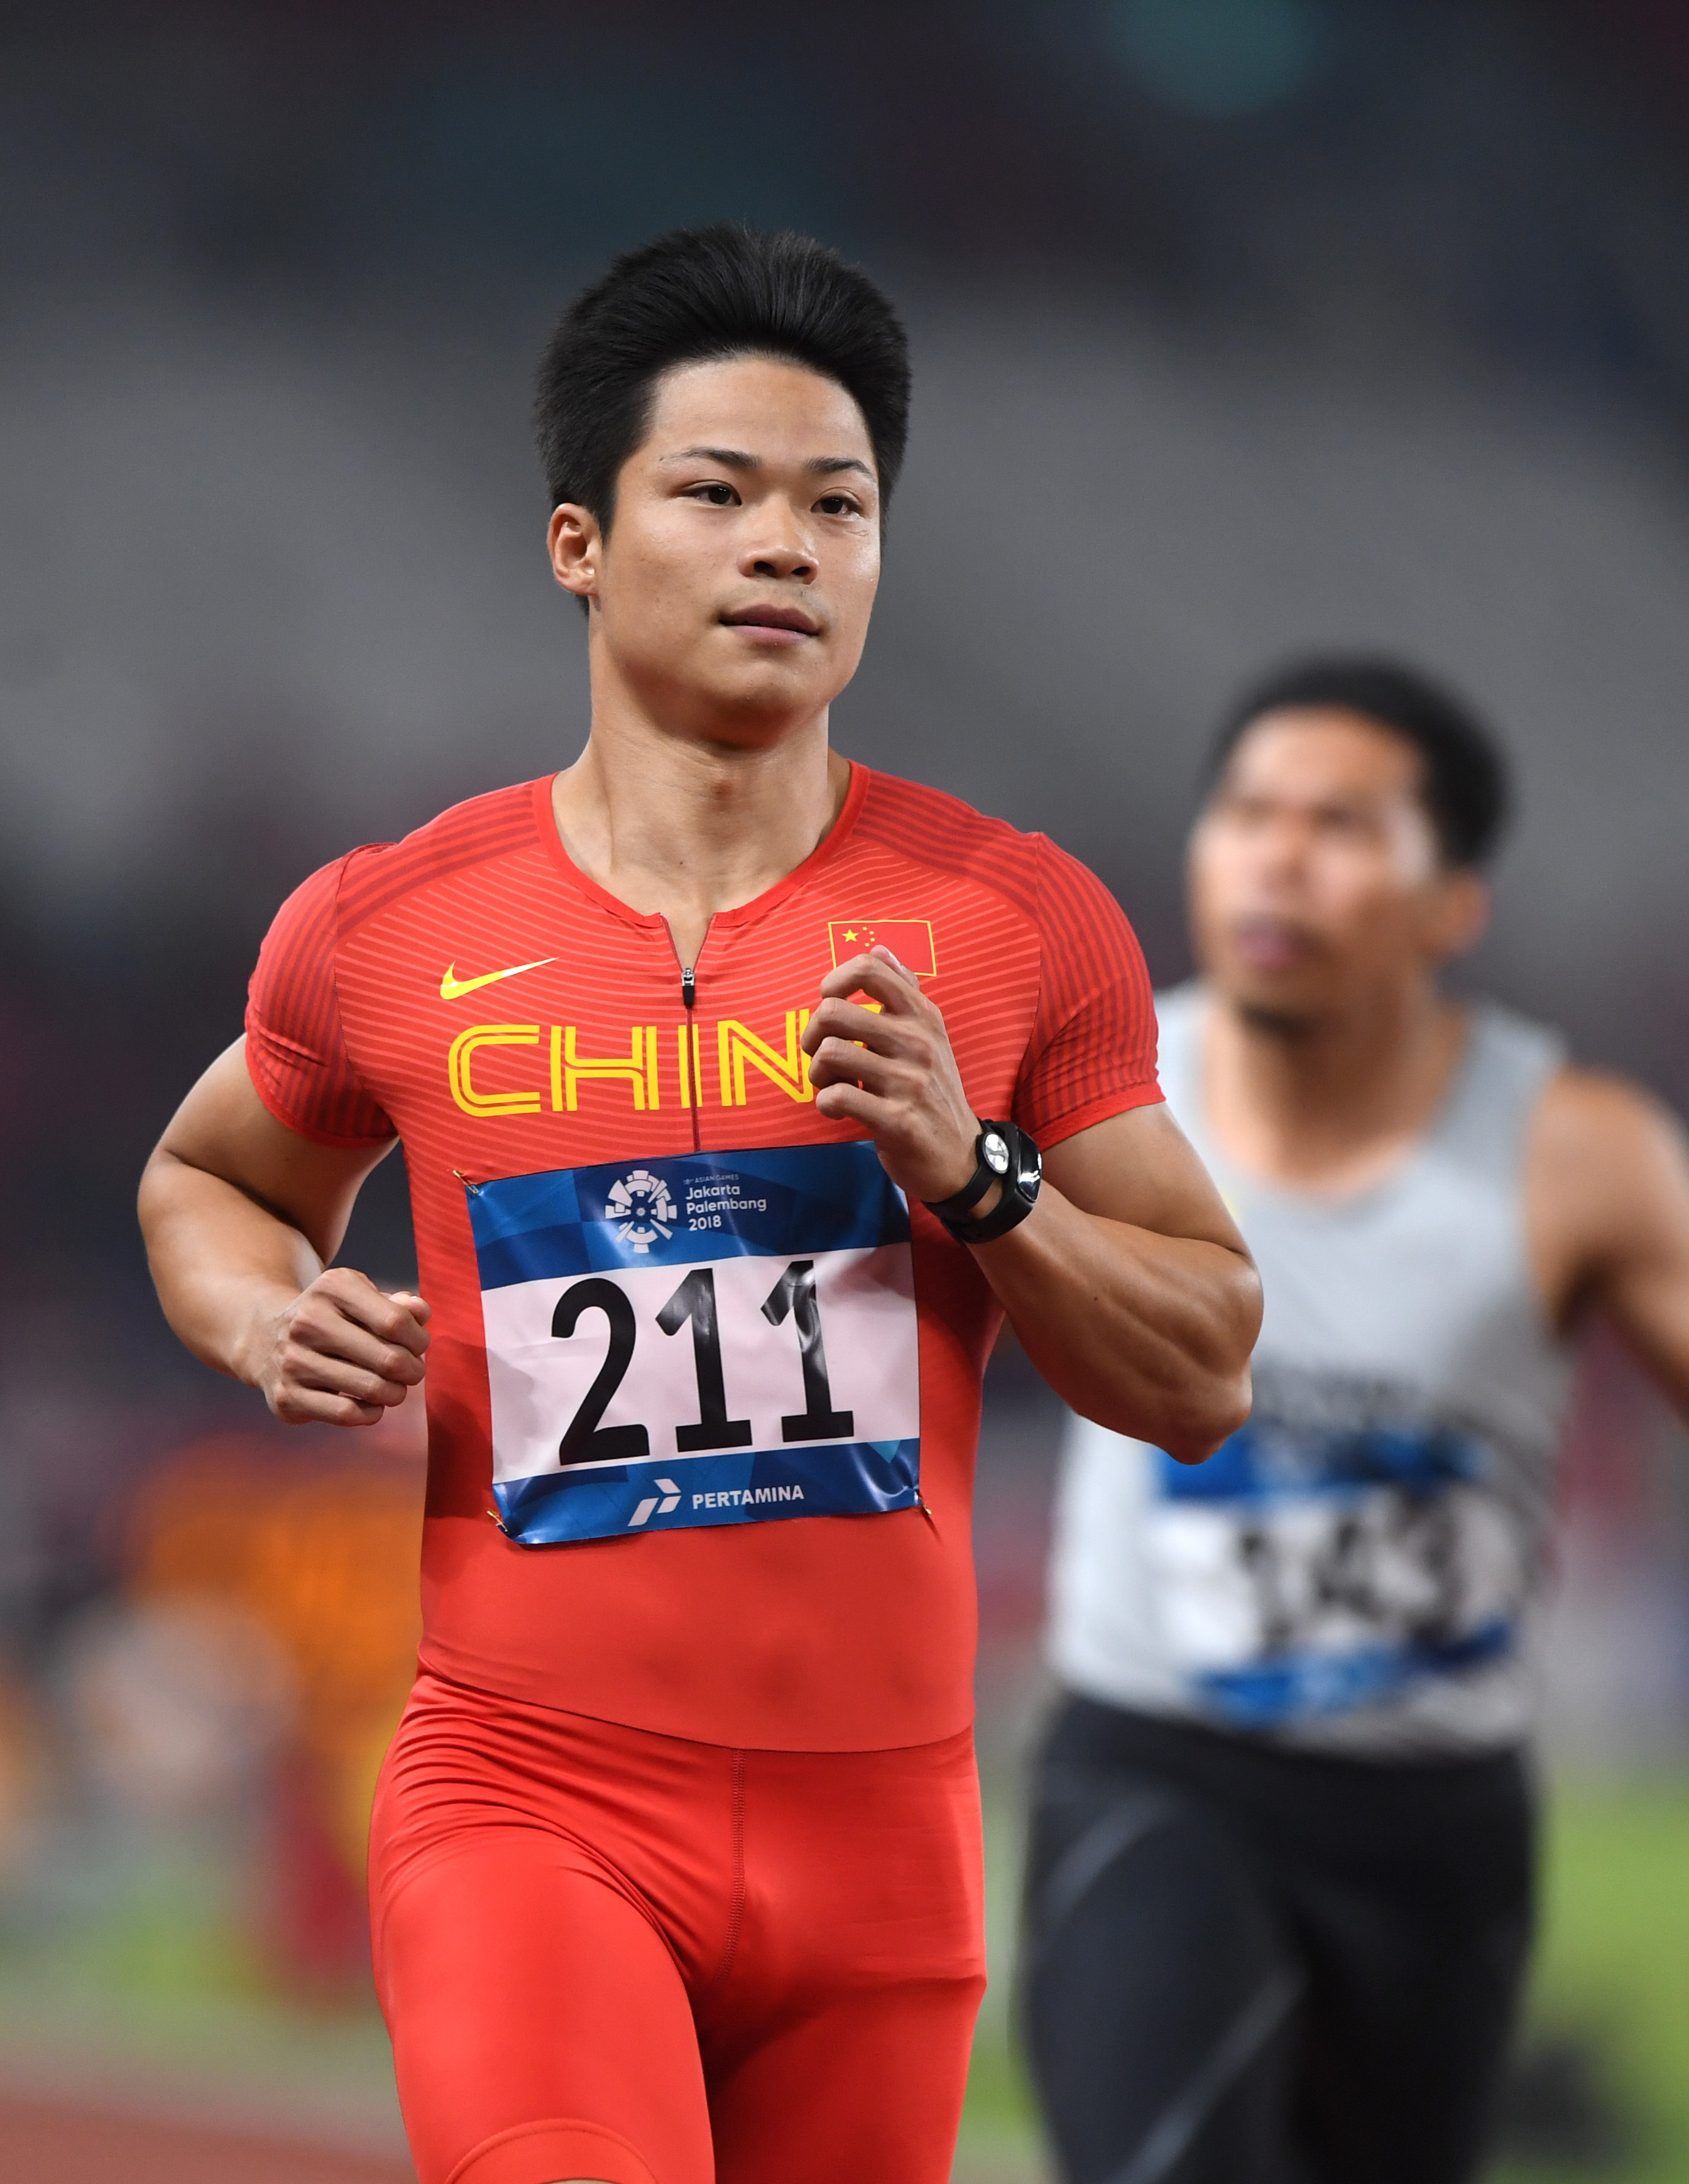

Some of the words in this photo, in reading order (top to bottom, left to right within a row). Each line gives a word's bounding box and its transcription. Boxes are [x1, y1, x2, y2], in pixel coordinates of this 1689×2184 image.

[448, 1004, 882, 1117] CHIN
[685, 1184, 740, 1200] Jakarta
[686, 1198, 767, 1215] Palembang
[688, 1215, 722, 1232] 2018
[551, 1259, 854, 1466] 211
[692, 1484, 805, 1510] PERTAMINA
